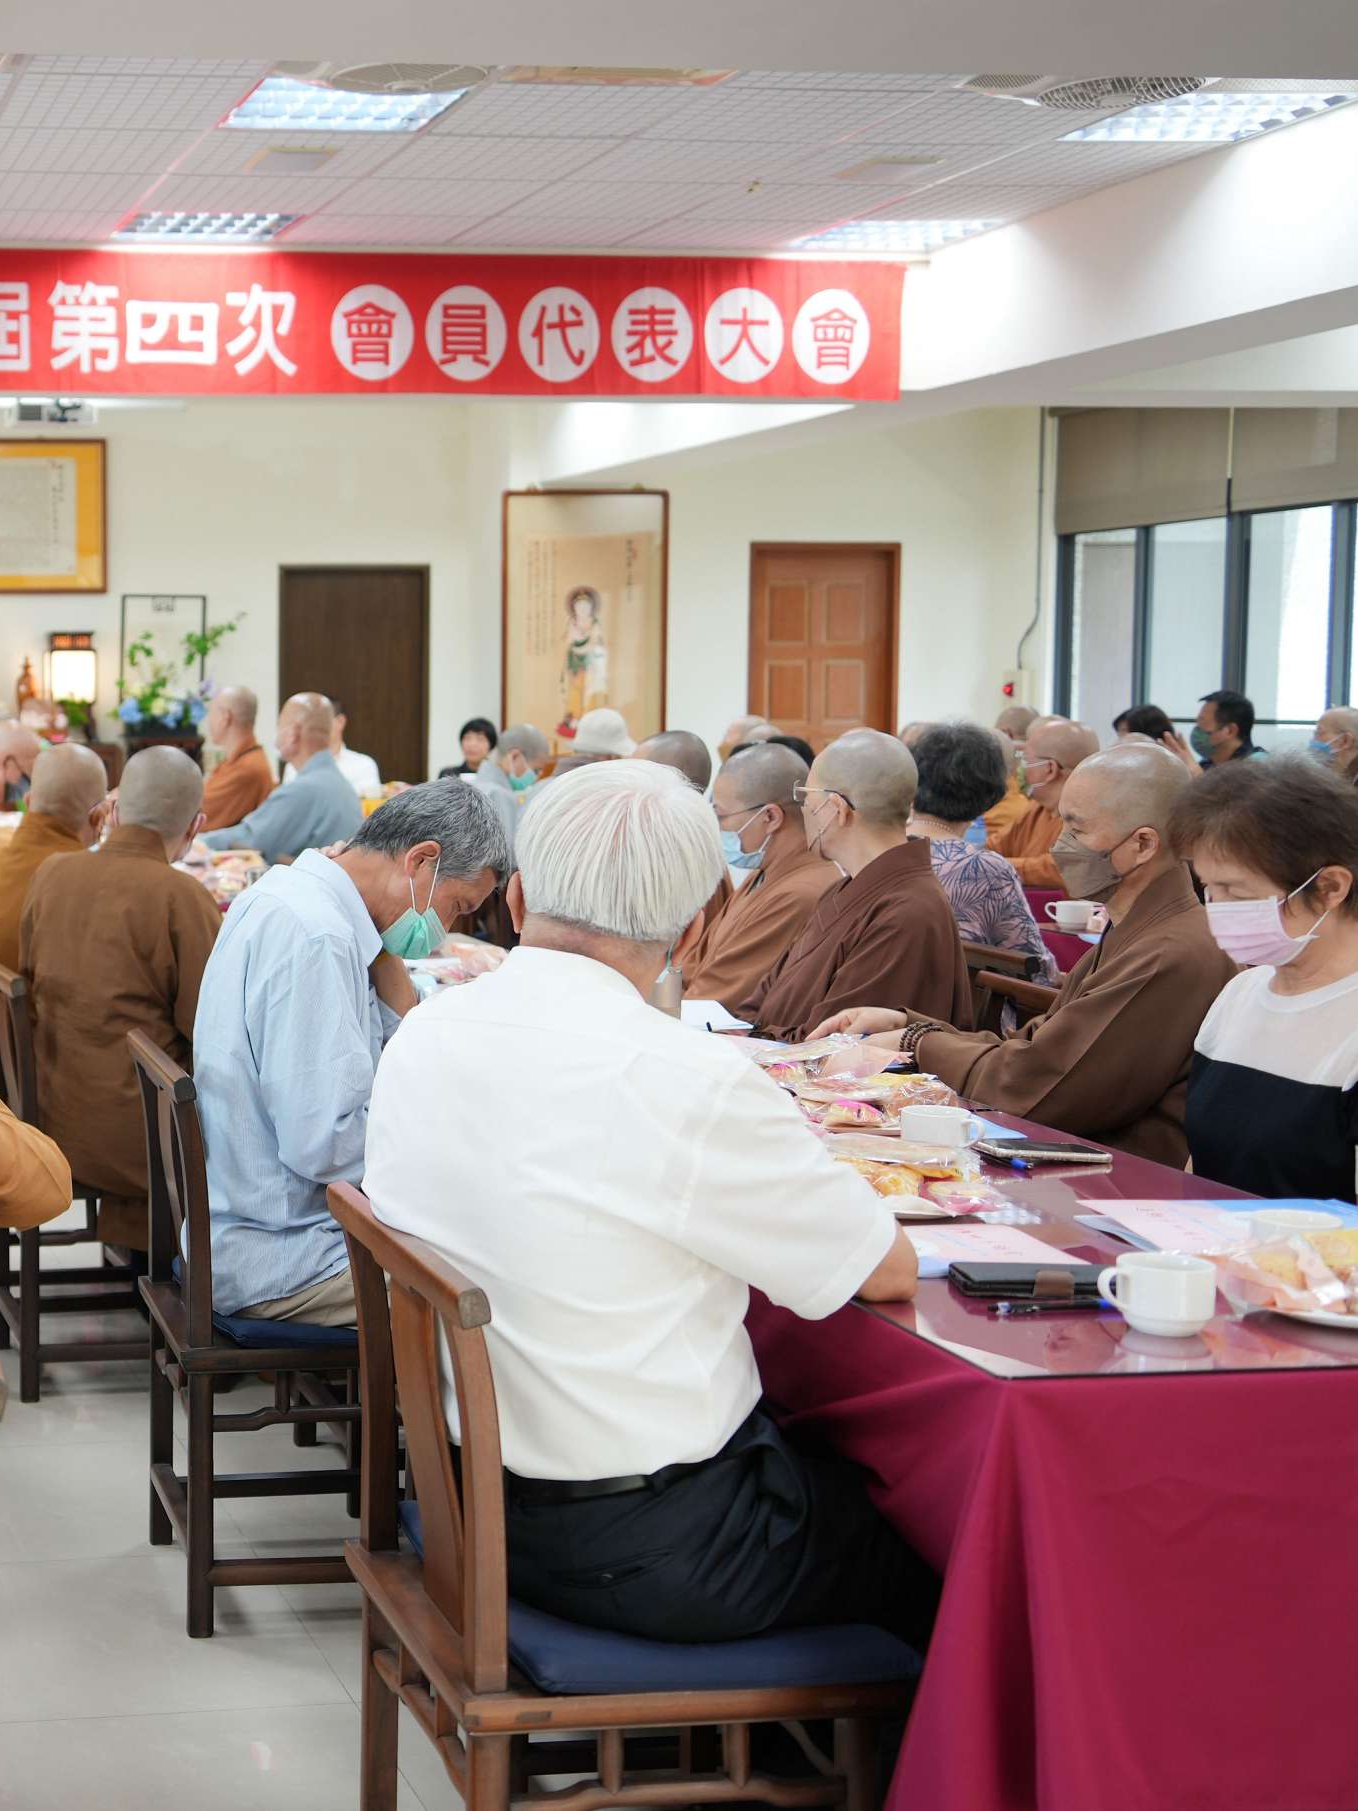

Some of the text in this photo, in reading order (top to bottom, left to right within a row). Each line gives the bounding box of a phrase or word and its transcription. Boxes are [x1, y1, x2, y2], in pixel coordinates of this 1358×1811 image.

[338, 300, 863, 375] 會員代表大會
